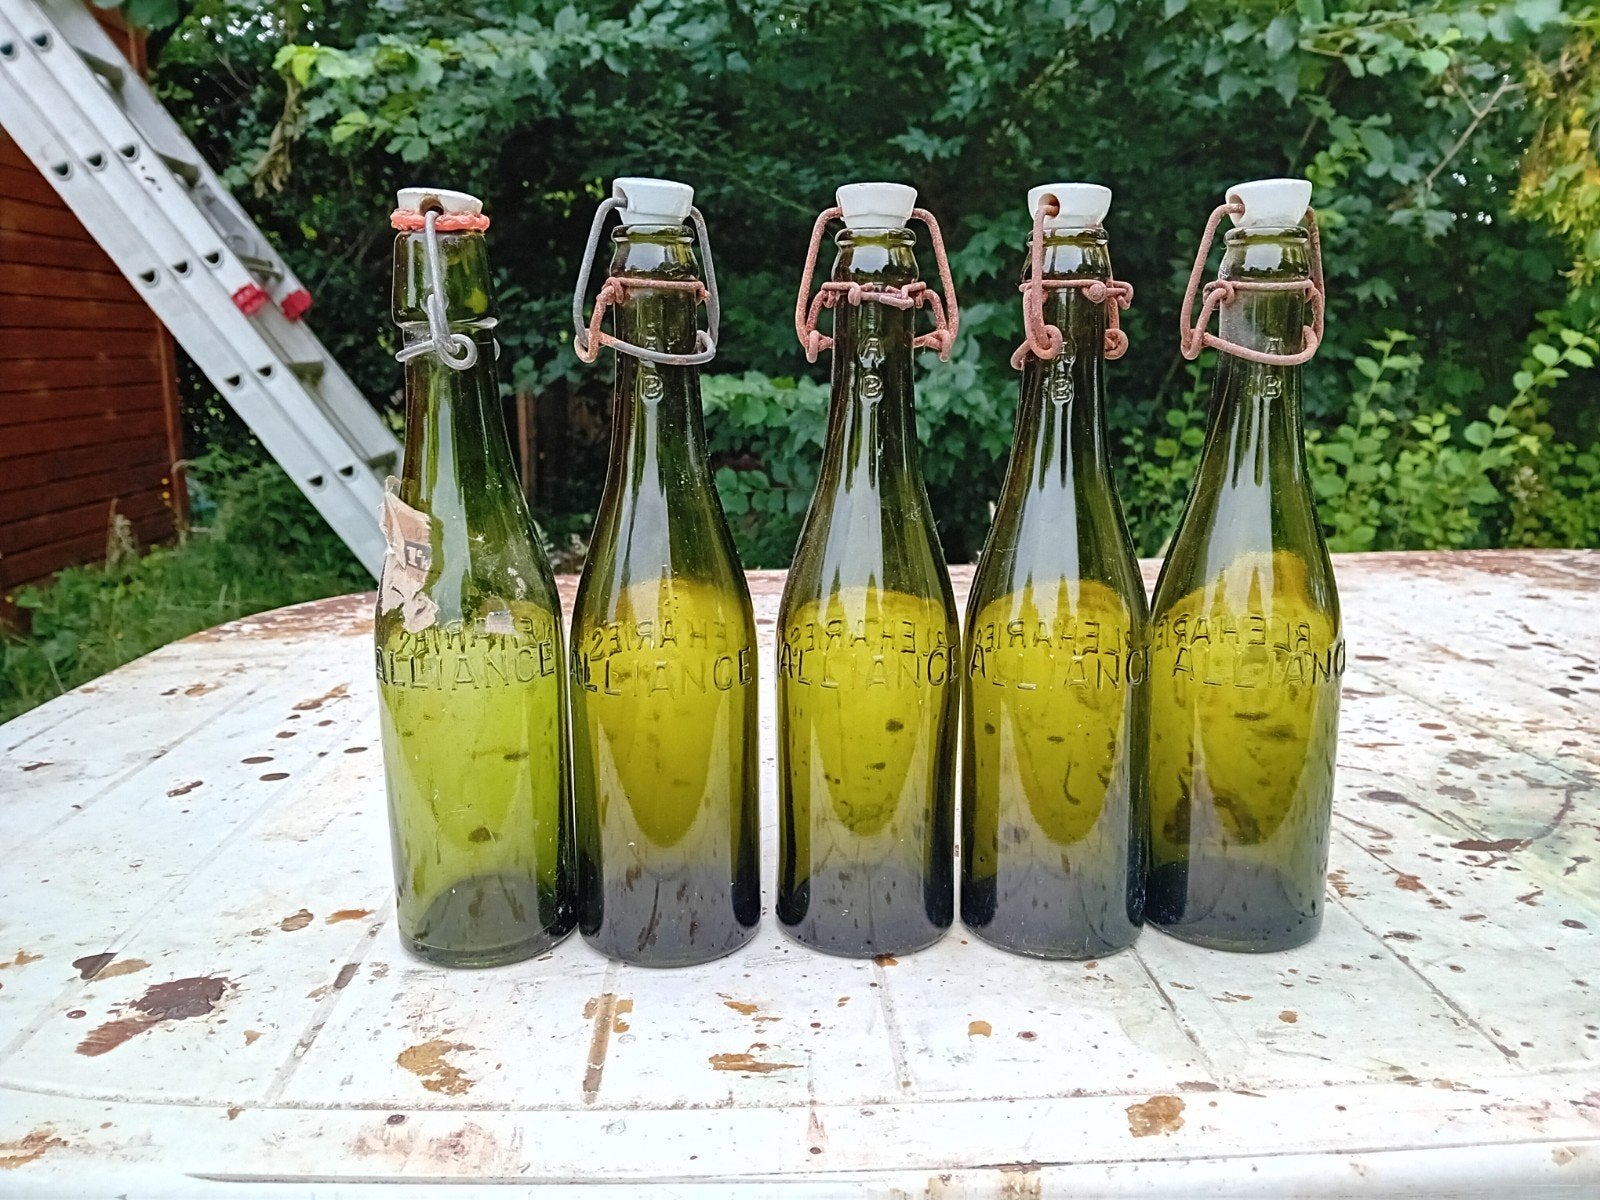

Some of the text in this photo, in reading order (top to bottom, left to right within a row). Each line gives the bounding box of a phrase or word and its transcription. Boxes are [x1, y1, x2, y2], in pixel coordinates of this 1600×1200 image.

[375, 639, 555, 690] ALLIANCE
[570, 646, 753, 698] ALLIANCE
[778, 640, 959, 691] ALLIANCE
[1171, 638, 1347, 689] ALLIANC
